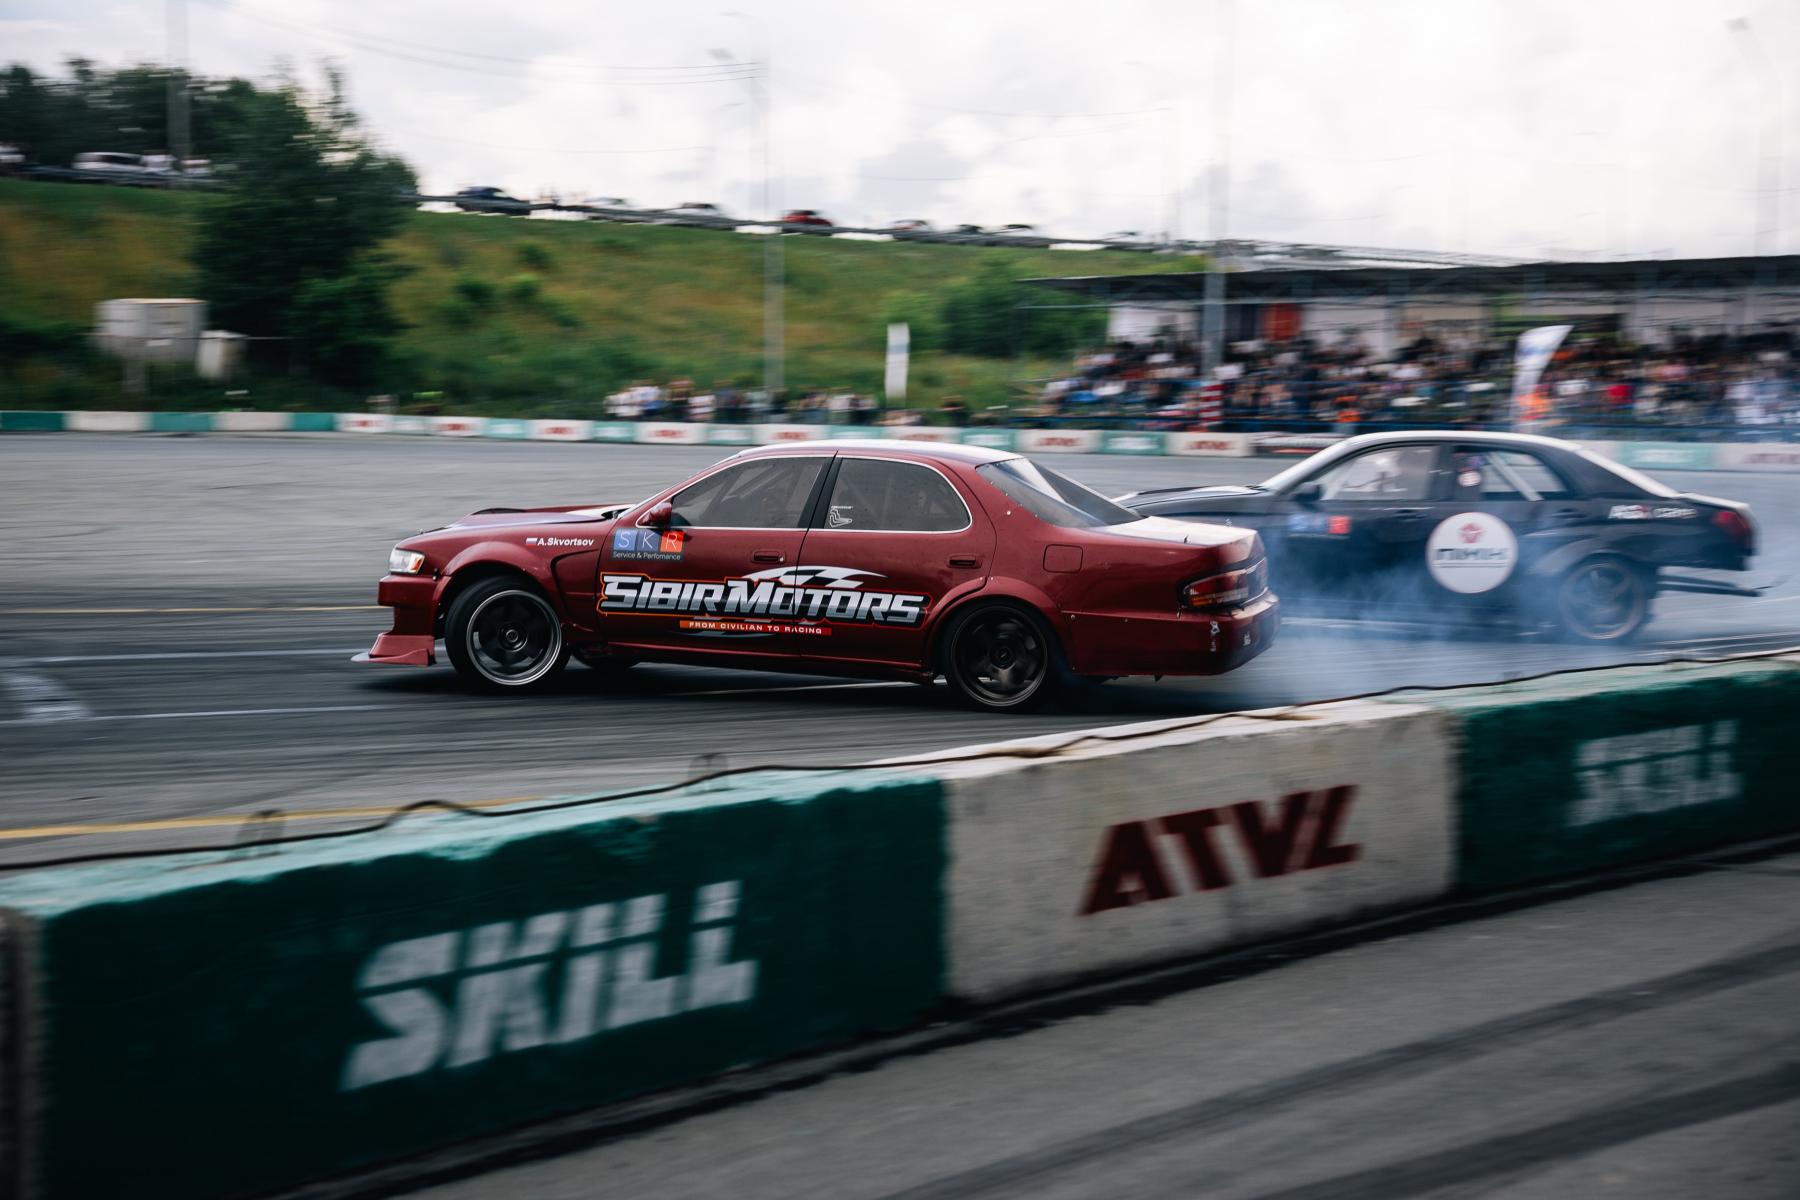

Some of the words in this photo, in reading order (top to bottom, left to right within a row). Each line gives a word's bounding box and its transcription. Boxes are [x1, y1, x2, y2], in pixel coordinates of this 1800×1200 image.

[537, 537, 595, 546] A.Skvortsov
[618, 530, 678, 550] SKR
[689, 621, 716, 629] FROM
[720, 623, 763, 631] CIVILIAN
[784, 626, 822, 634] RACING
[340, 880, 758, 1092] SKILL
